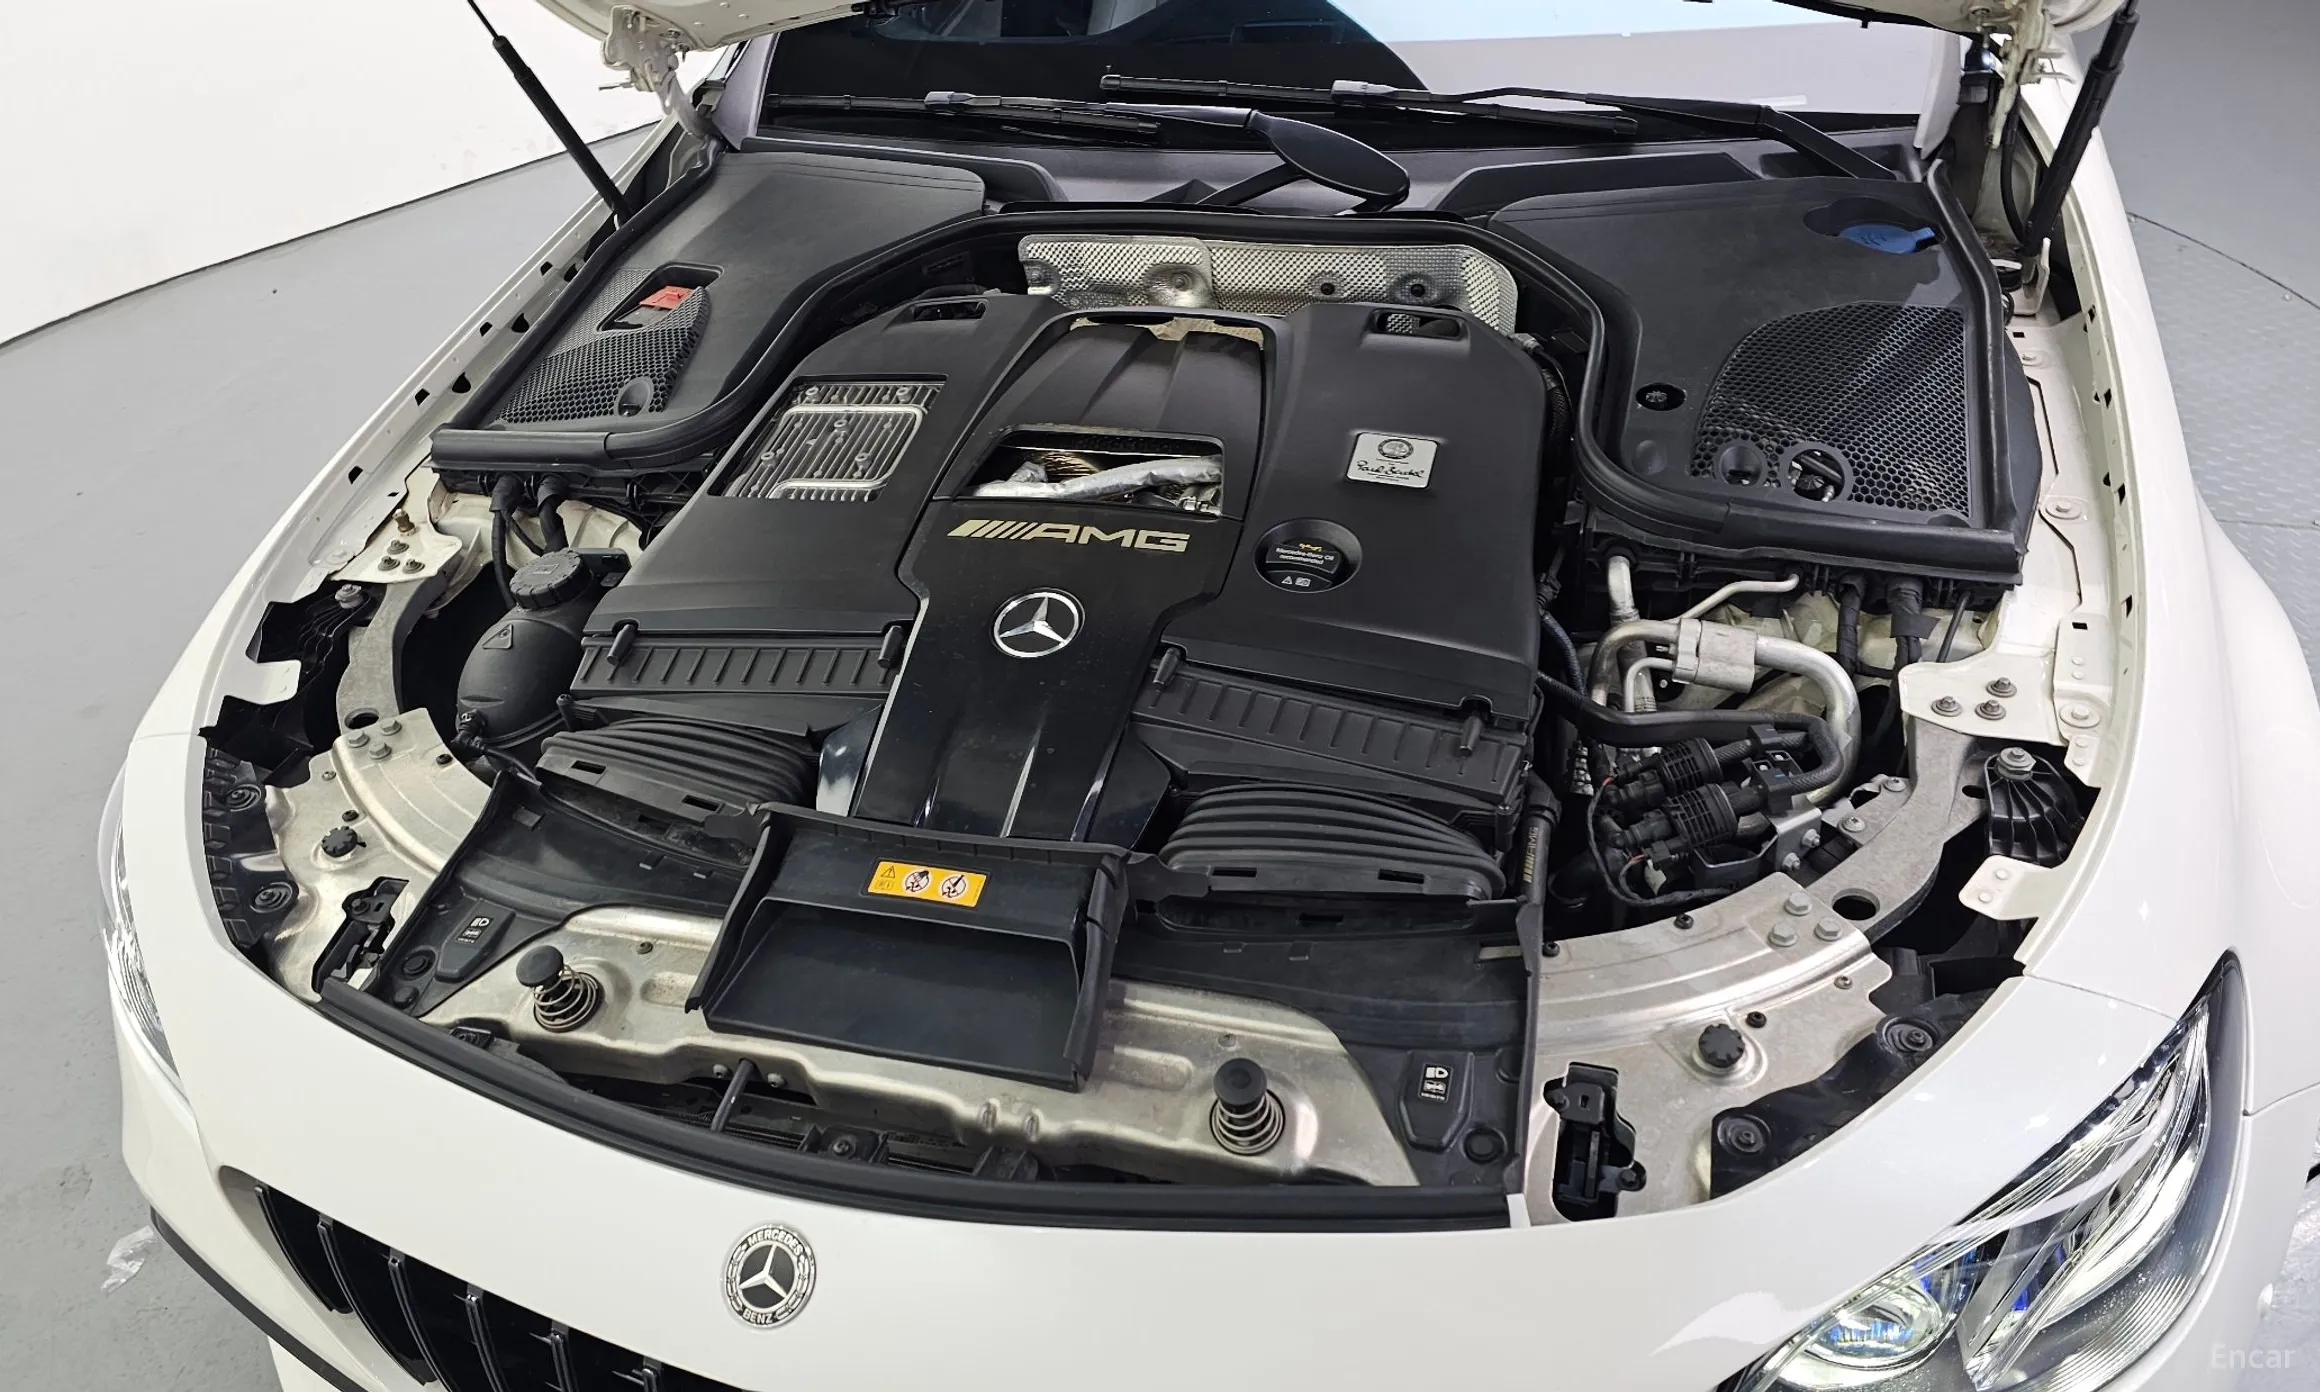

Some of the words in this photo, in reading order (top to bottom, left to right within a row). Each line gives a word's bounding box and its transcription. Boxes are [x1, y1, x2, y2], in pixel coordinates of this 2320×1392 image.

[1021, 522, 1191, 553] AMG
[747, 1229, 804, 1256] MERCEDES
[742, 1308, 774, 1324] BENZ
